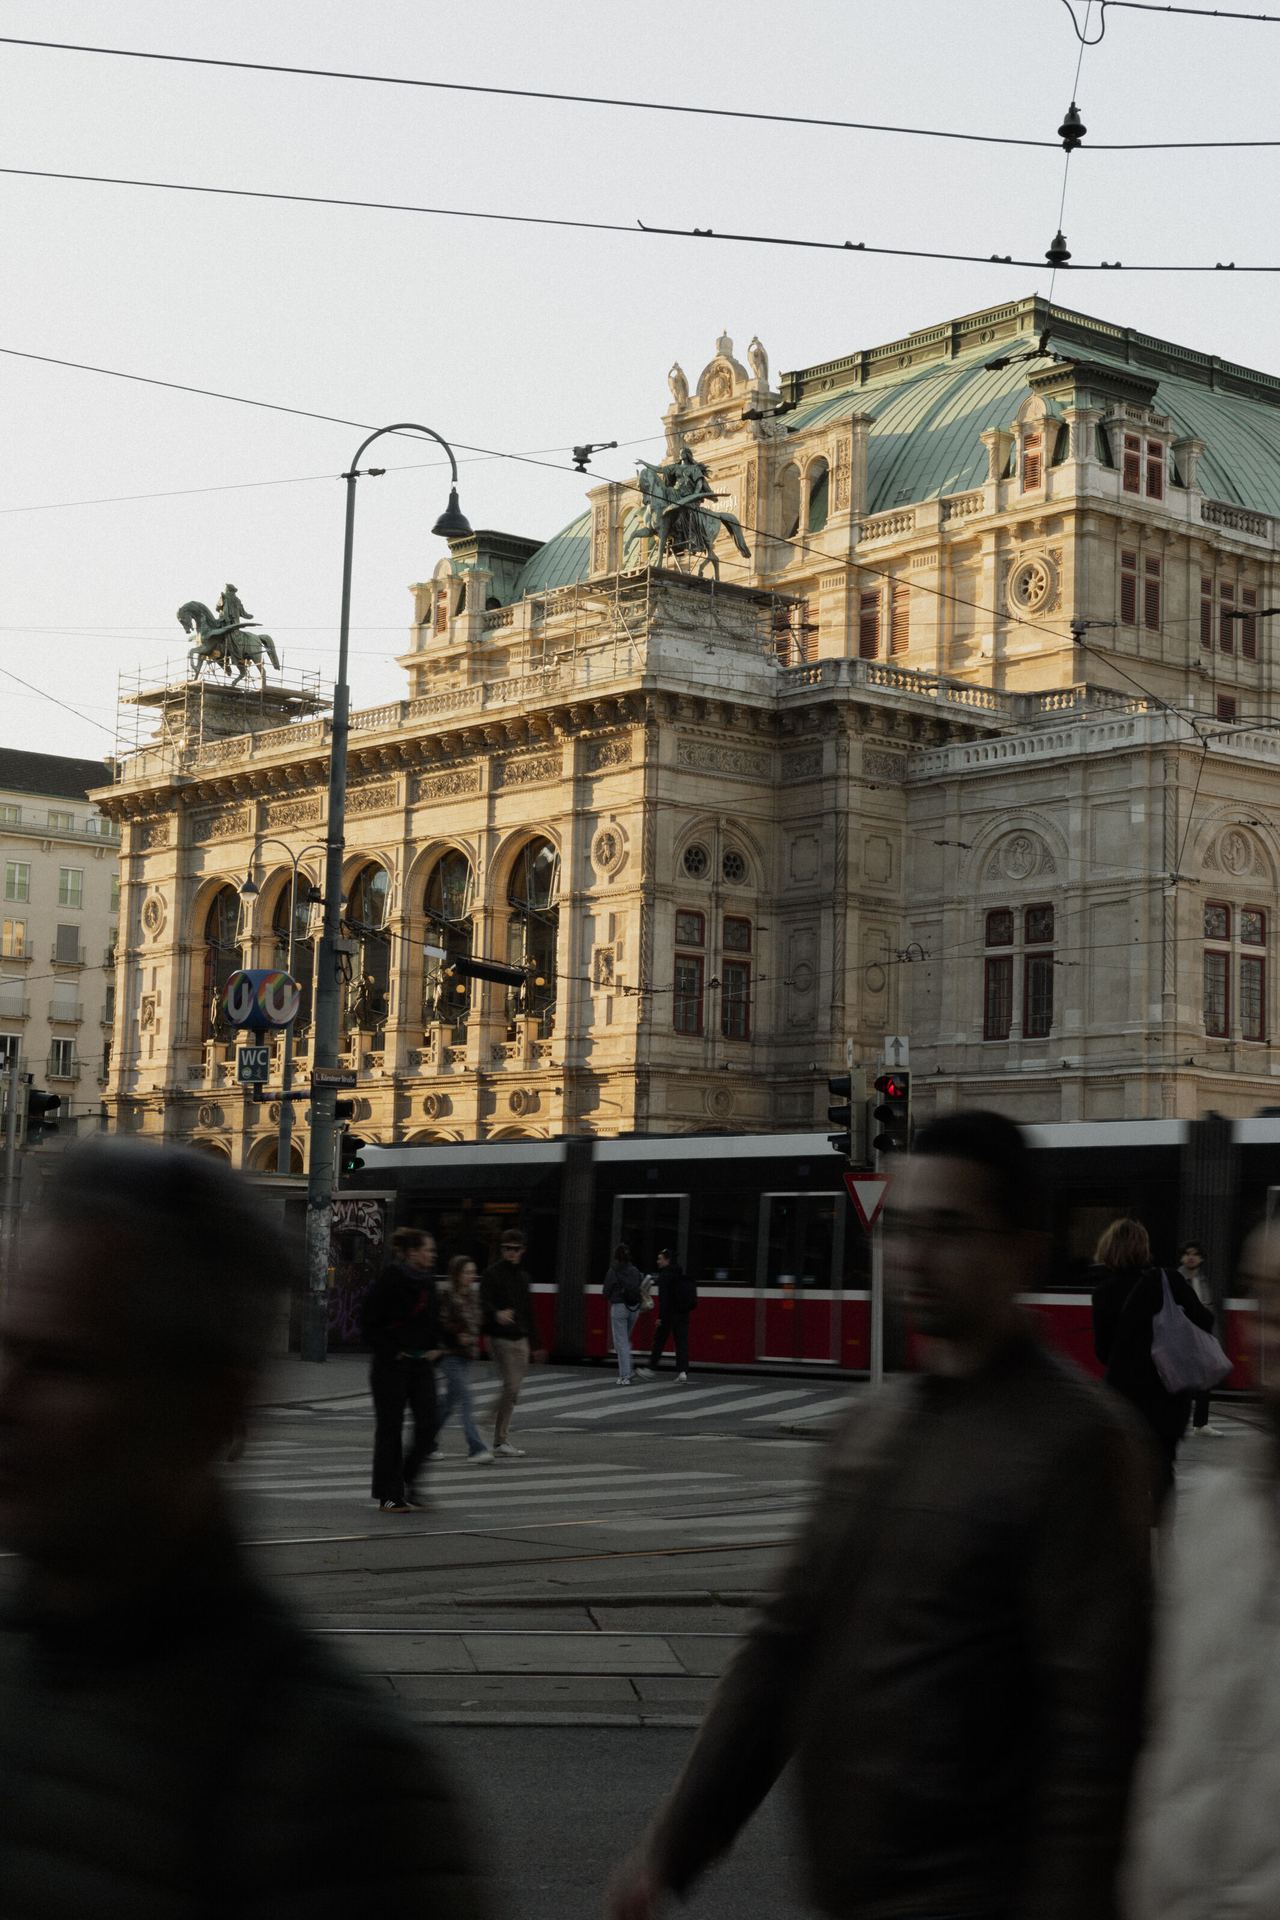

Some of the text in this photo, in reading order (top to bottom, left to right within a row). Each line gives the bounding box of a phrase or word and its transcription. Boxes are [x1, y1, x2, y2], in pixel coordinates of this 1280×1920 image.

[227, 983, 253, 1024] U
[265, 983, 299, 1024] U
[241, 1050, 267, 1066] WC
